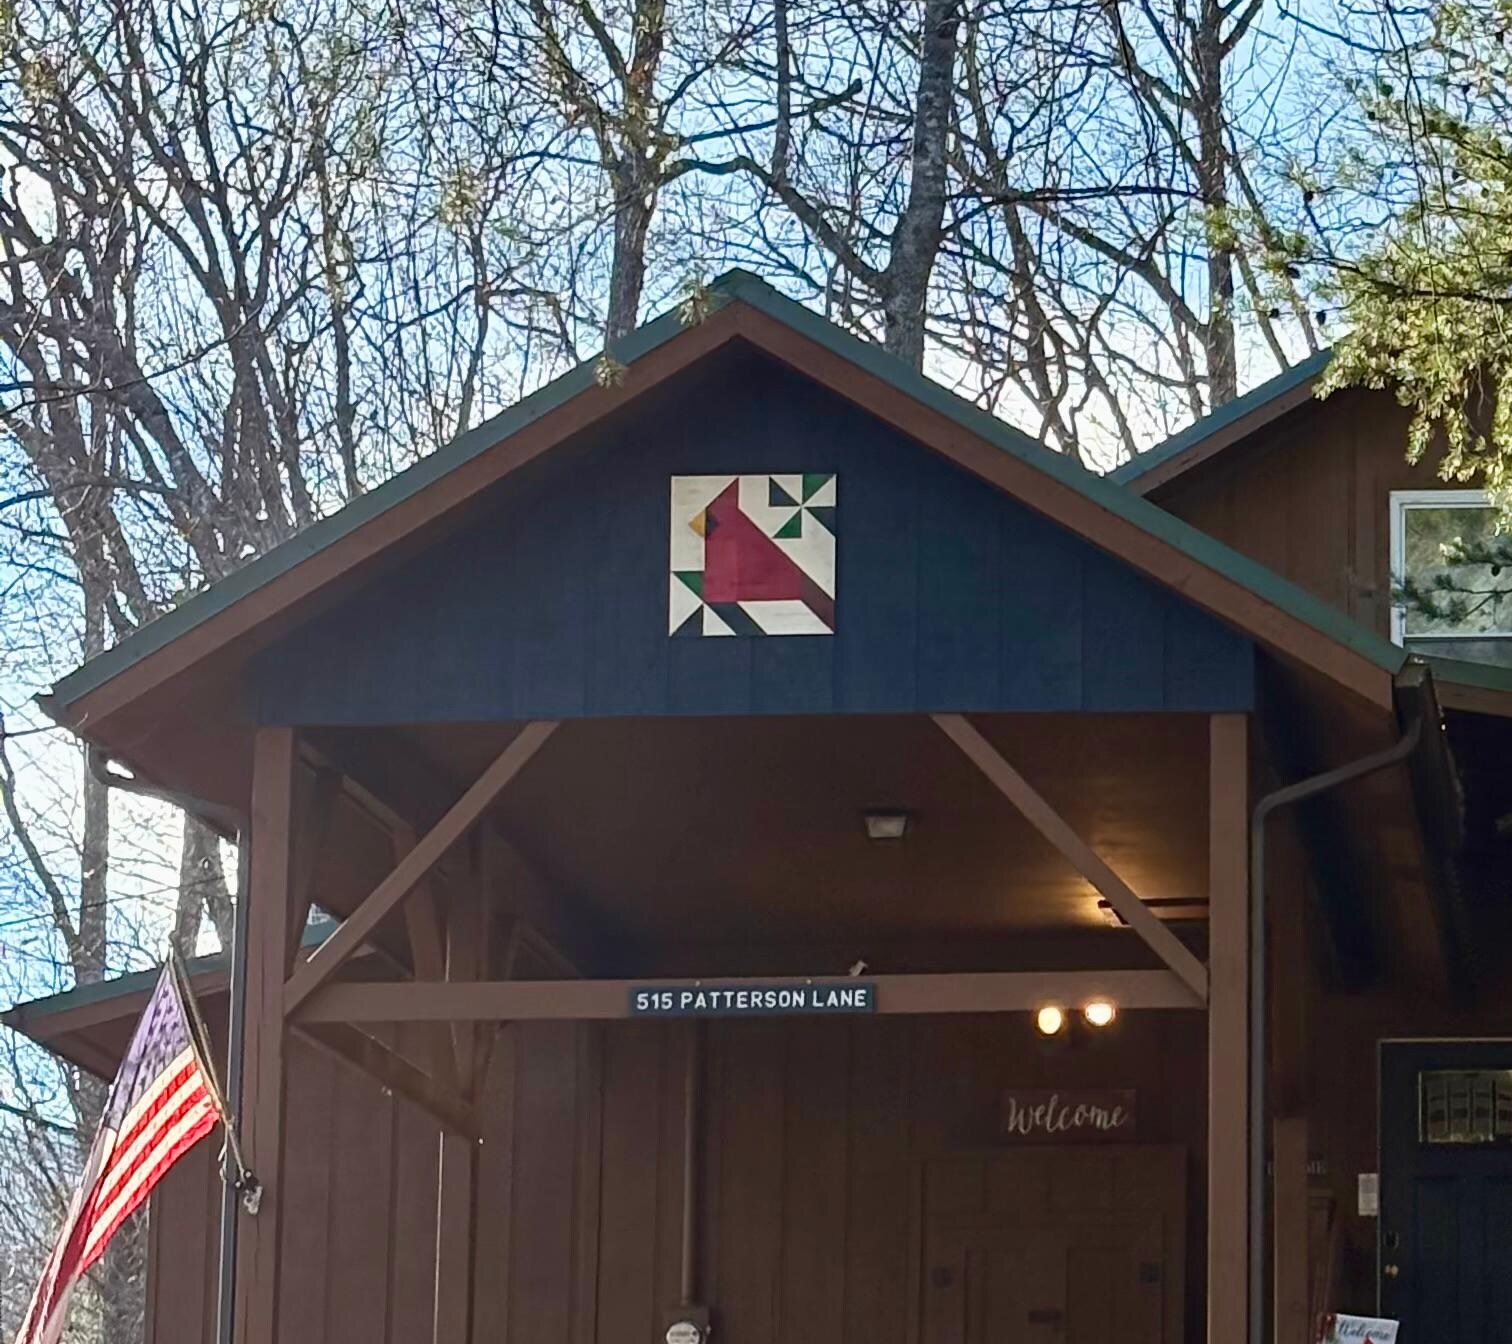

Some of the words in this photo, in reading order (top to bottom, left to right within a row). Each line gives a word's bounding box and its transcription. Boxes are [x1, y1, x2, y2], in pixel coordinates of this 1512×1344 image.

[636, 992, 673, 1010] 515
[680, 990, 806, 1009] PATTERSON
[812, 989, 867, 1007] LANE
[1008, 1093, 1128, 1134] Welcome
